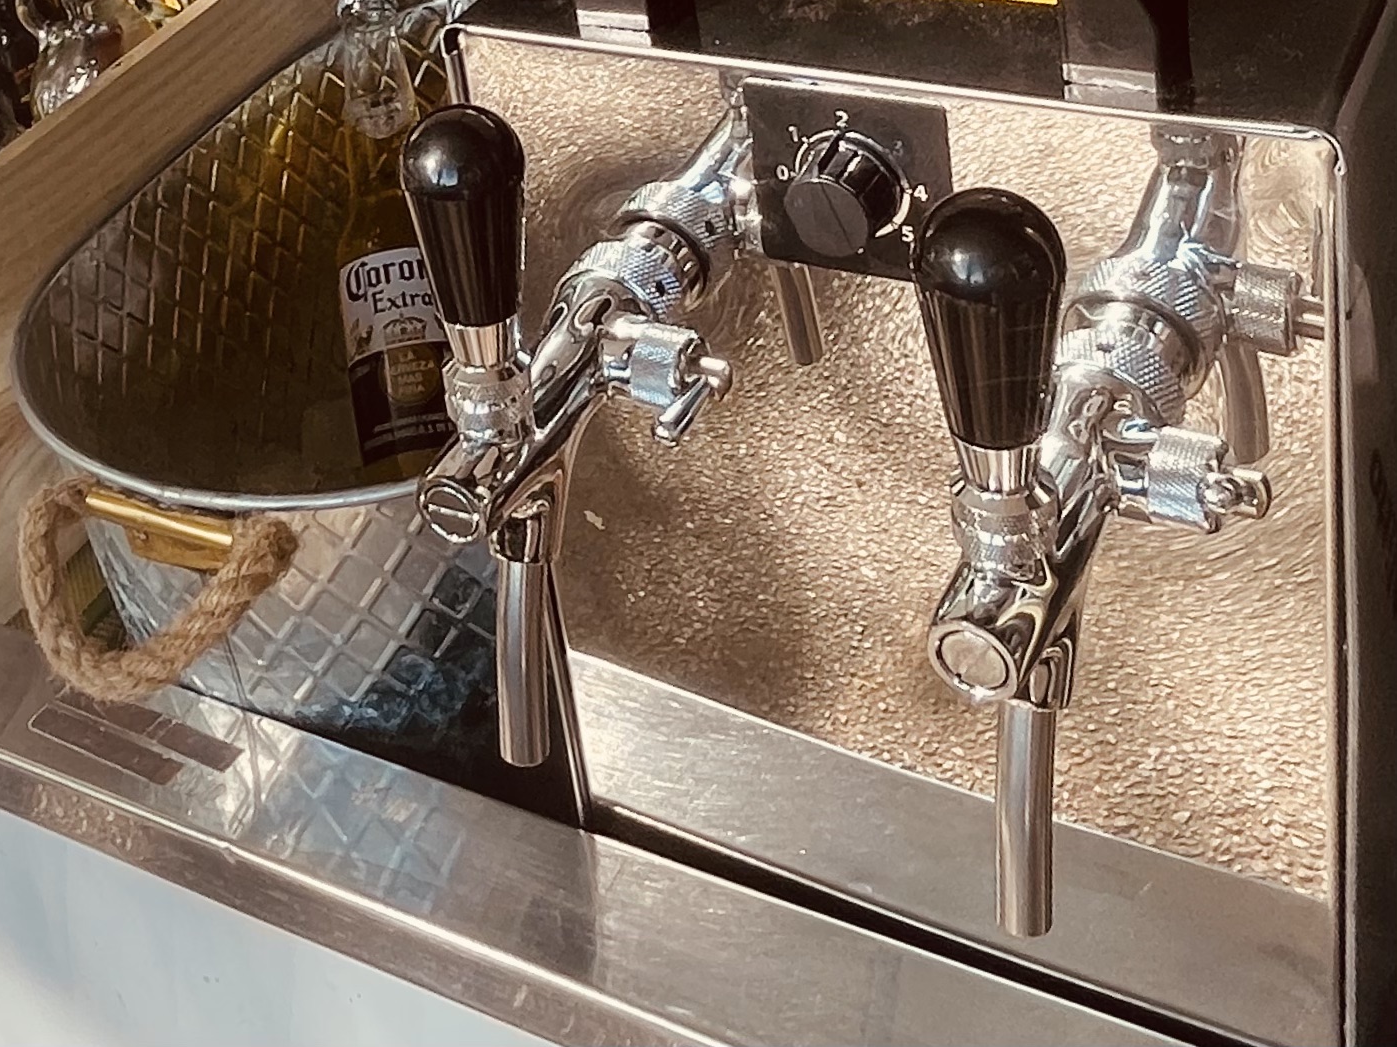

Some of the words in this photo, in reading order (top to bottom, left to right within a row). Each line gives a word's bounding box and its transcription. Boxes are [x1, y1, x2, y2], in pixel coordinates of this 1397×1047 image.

[834, 109, 849, 128] 2
[787, 124, 799, 143] 1
[775, 164, 790, 181] 0
[913, 184, 929, 202] 4
[901, 226, 915, 243] 5
[345, 257, 426, 304] Coro
[370, 288, 435, 316] Extra
